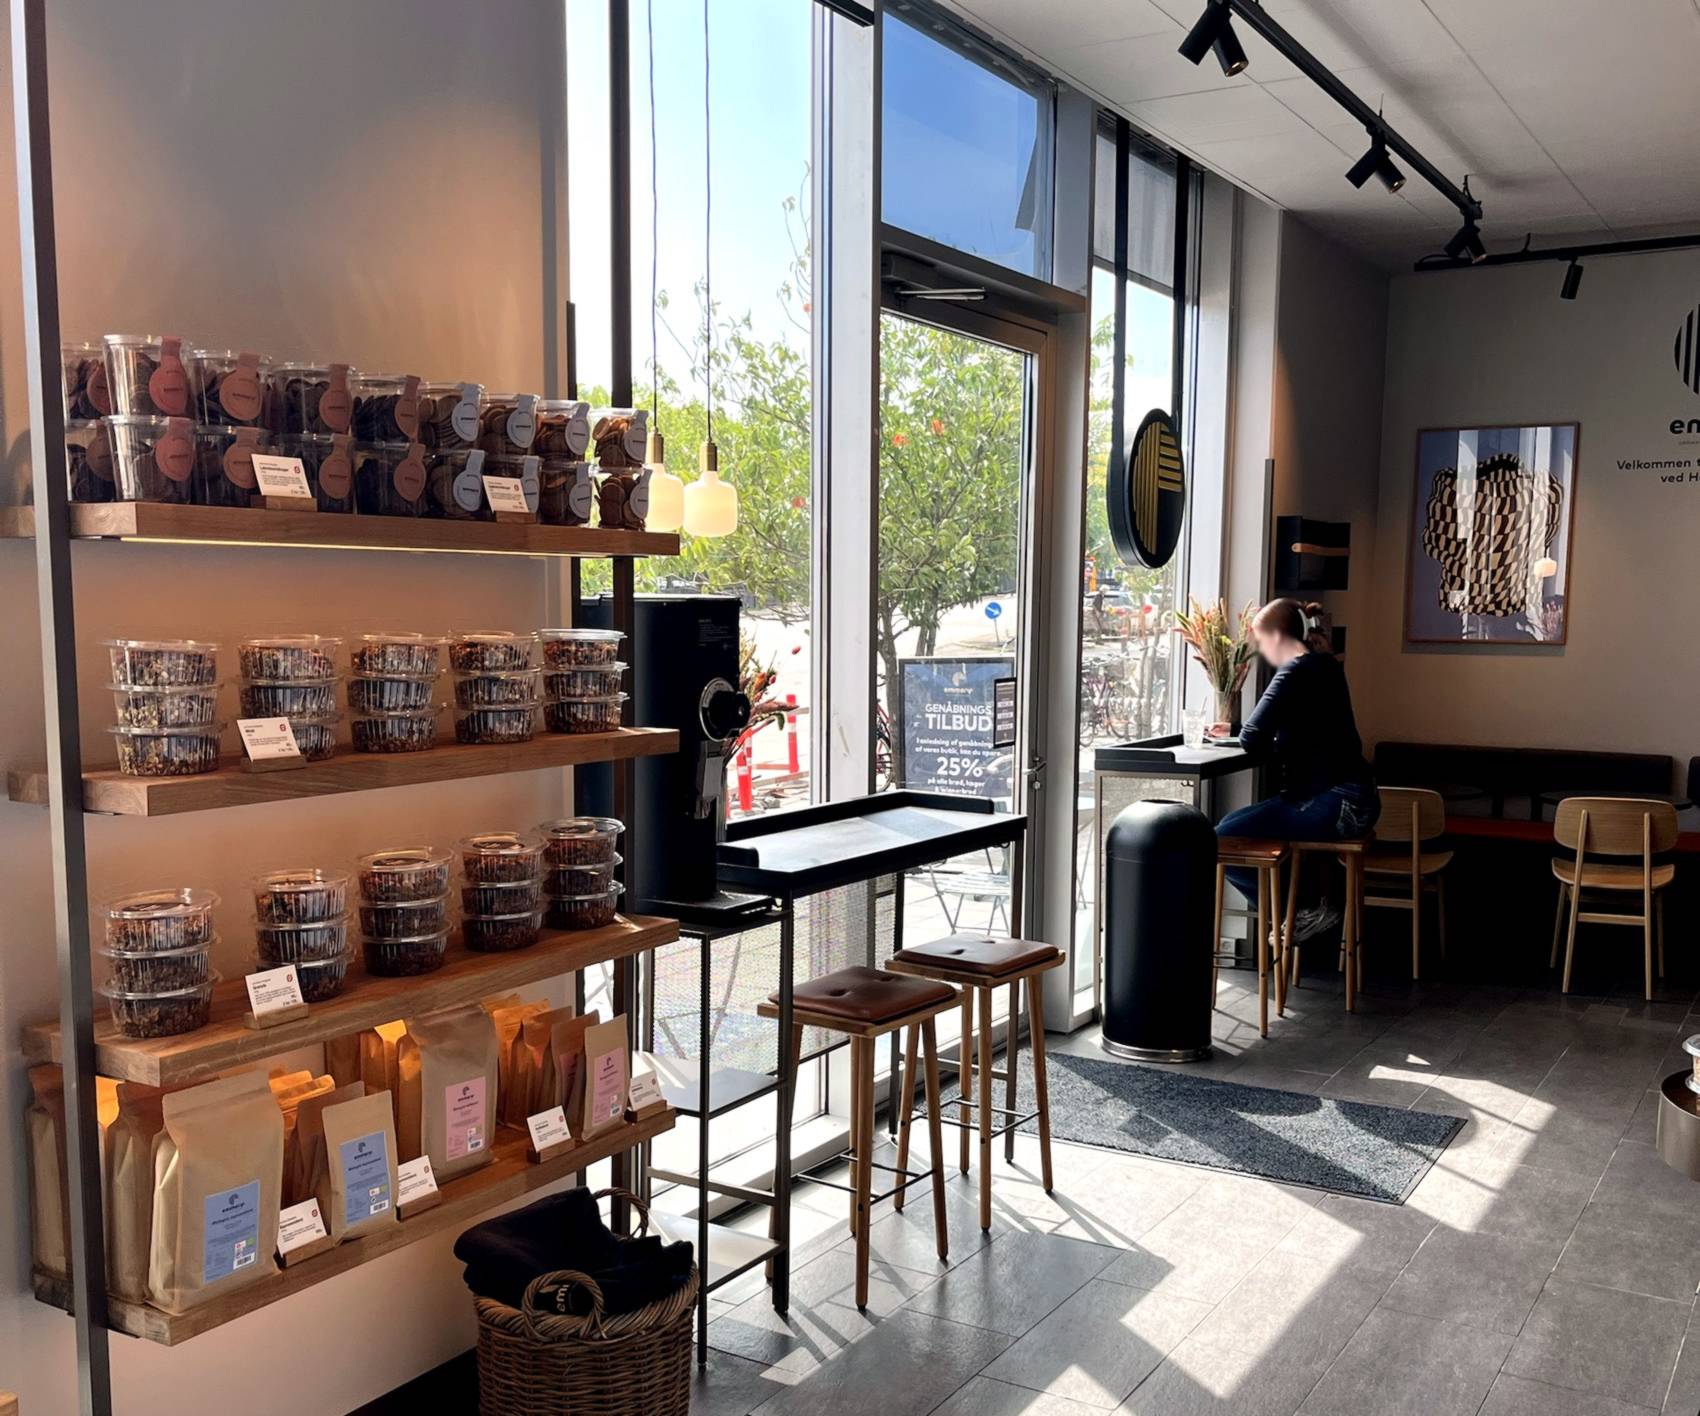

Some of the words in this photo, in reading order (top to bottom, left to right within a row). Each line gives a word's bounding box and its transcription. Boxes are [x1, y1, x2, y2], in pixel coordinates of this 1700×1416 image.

[1617, 460, 1691, 470] Velkommen
[1661, 472, 1684, 482] ved
[1689, 472, 1700, 482] H
[925, 714, 992, 732] TILBUD
[937, 757, 983, 778] 25%
